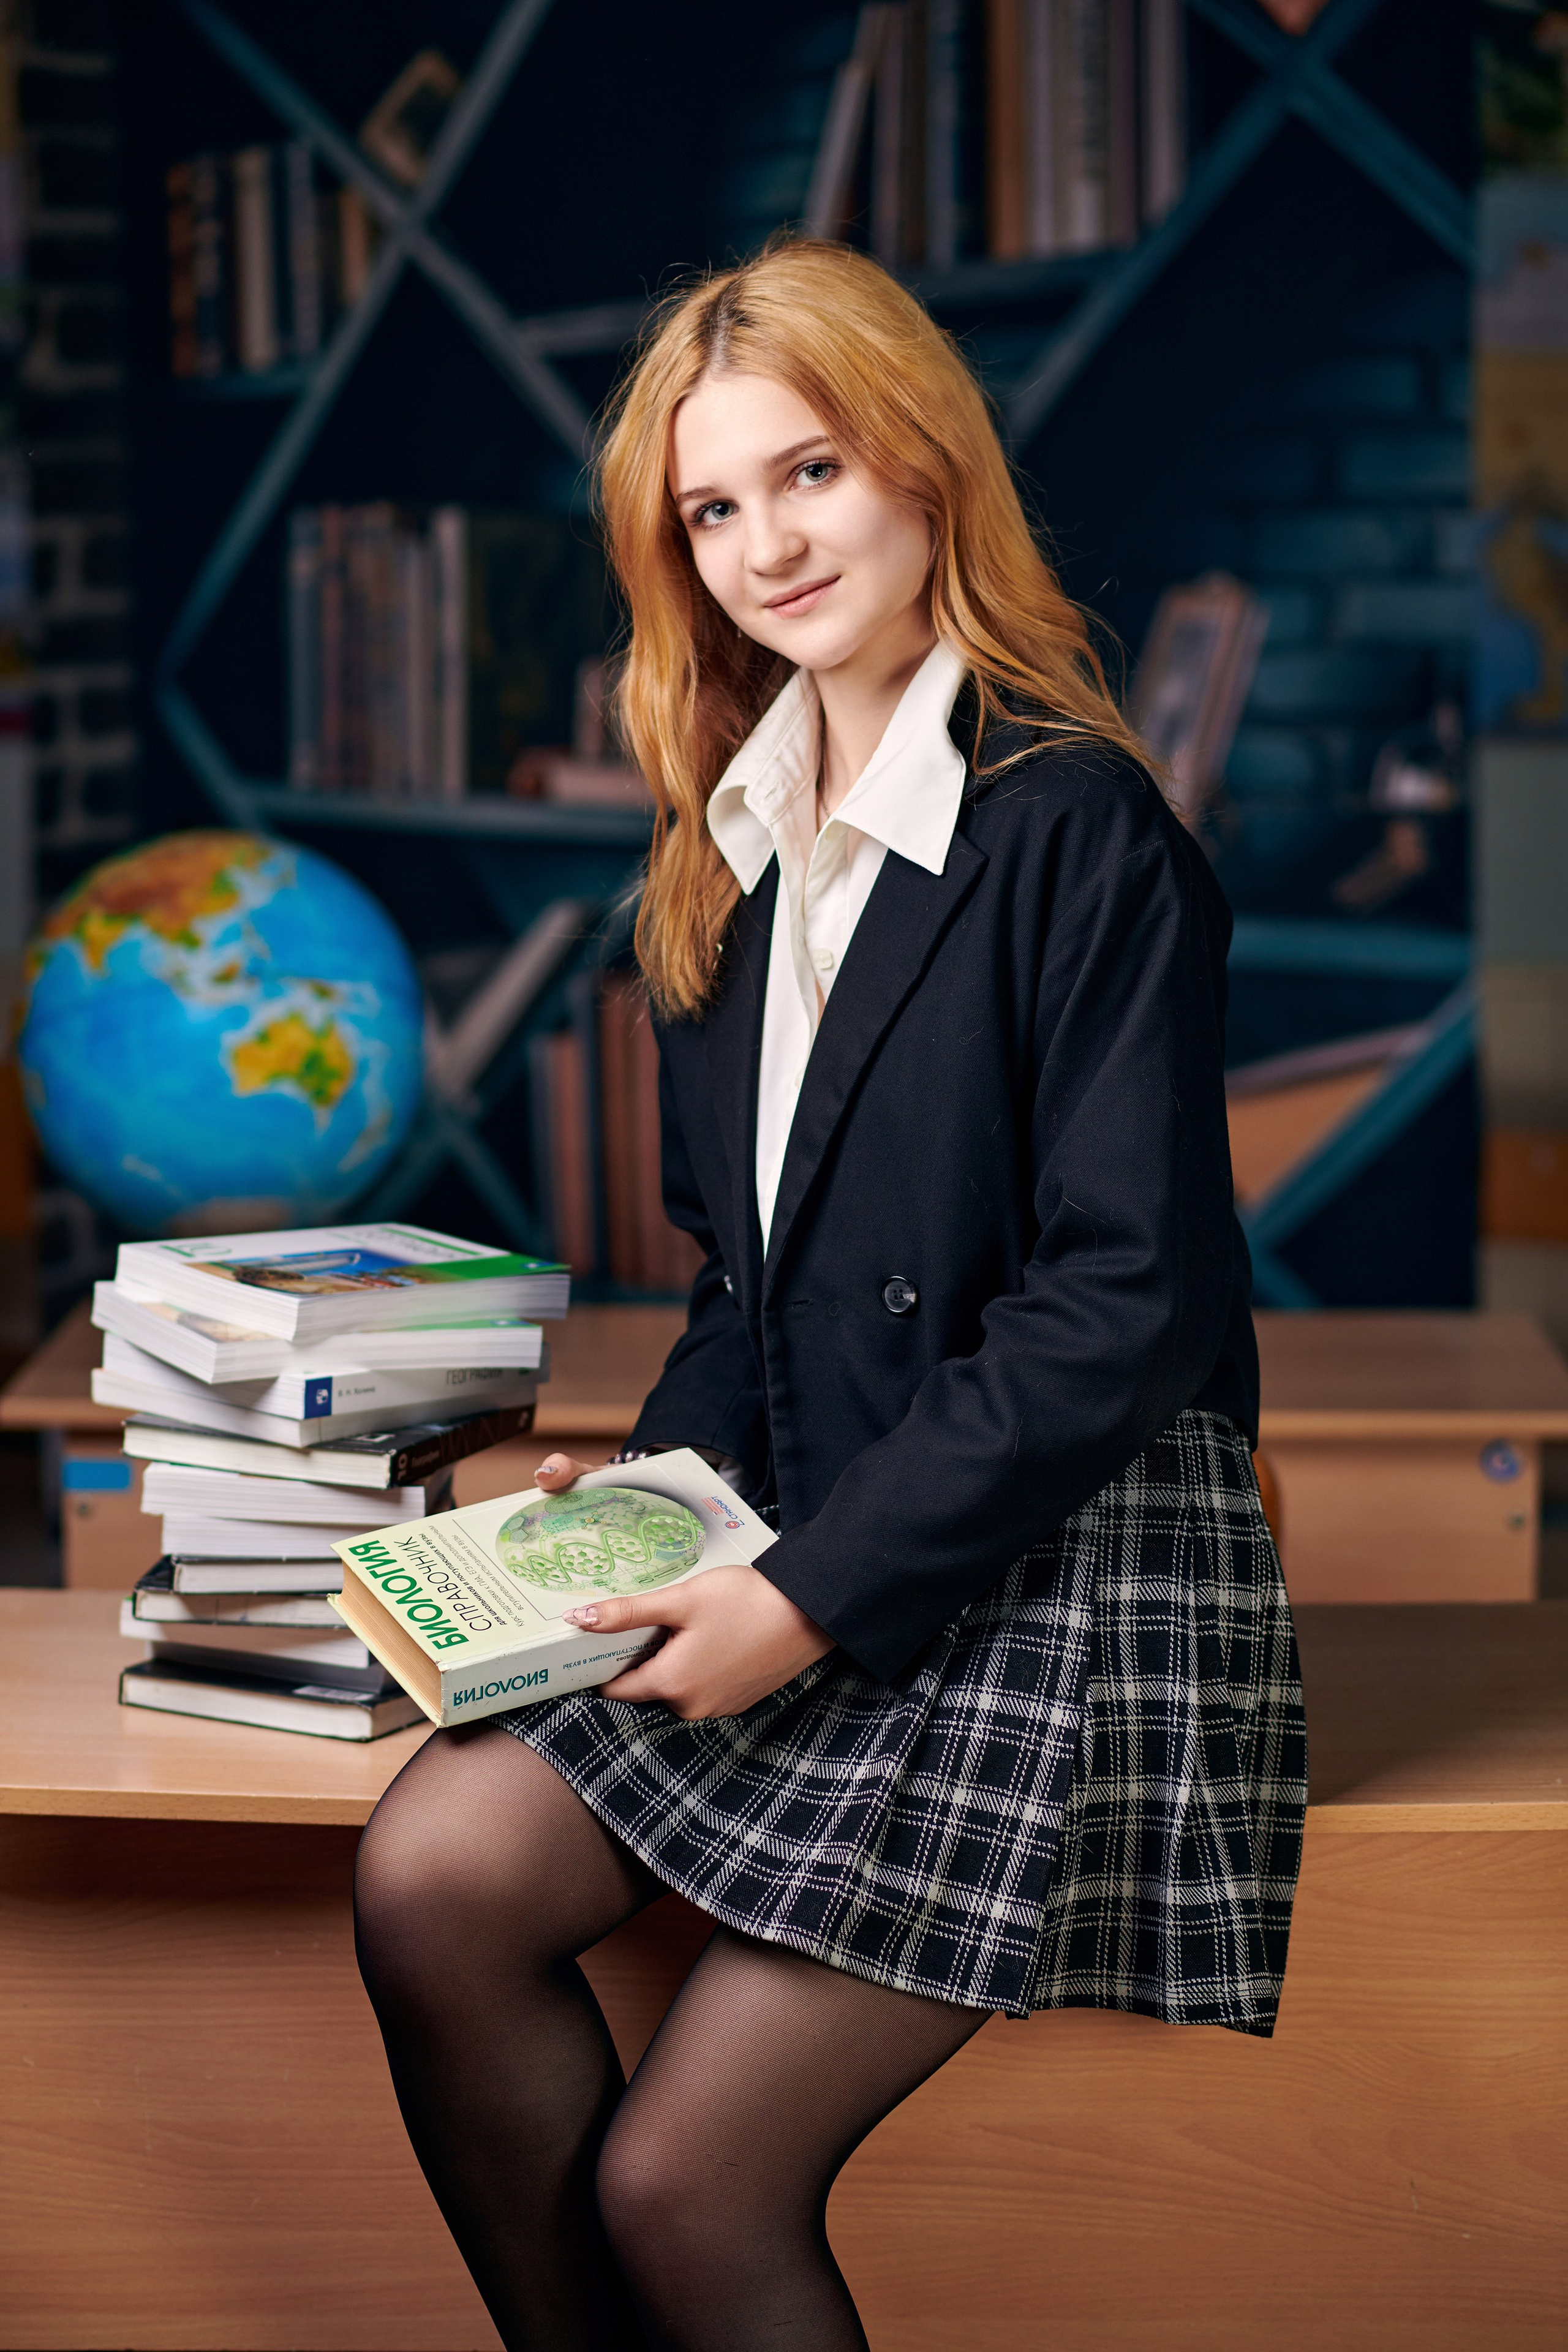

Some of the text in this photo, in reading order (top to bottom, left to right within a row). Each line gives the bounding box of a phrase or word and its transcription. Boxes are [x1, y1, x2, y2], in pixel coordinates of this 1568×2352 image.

[418, 1533, 433, 1545] вузы
[429, 1525, 467, 1562] дополнительным
[450, 1534, 465, 1545] вузы
[433, 1549, 466, 1581] поступающих
[464, 1549, 493, 1576] испытаниям
[464, 1565, 477, 1575] ЕГЭ
[393, 1536, 494, 1630] СПРАВОЧНИК
[472, 1574, 488, 1586] ГИА,
[491, 1575, 524, 1610] вступительным
[347, 1539, 469, 1649] БИОЛОГИЯ
[466, 1586, 497, 1616] школьников
[488, 1589, 515, 1615] подготовки
[494, 1616, 507, 1626] для
[509, 1615, 525, 1626] Курс
[589, 1645, 642, 1662] ПОСТУПАЮЩИХ
[616, 1651, 644, 1662] Солодова
[453, 1668, 548, 1706] БИОЛОГИЯ
